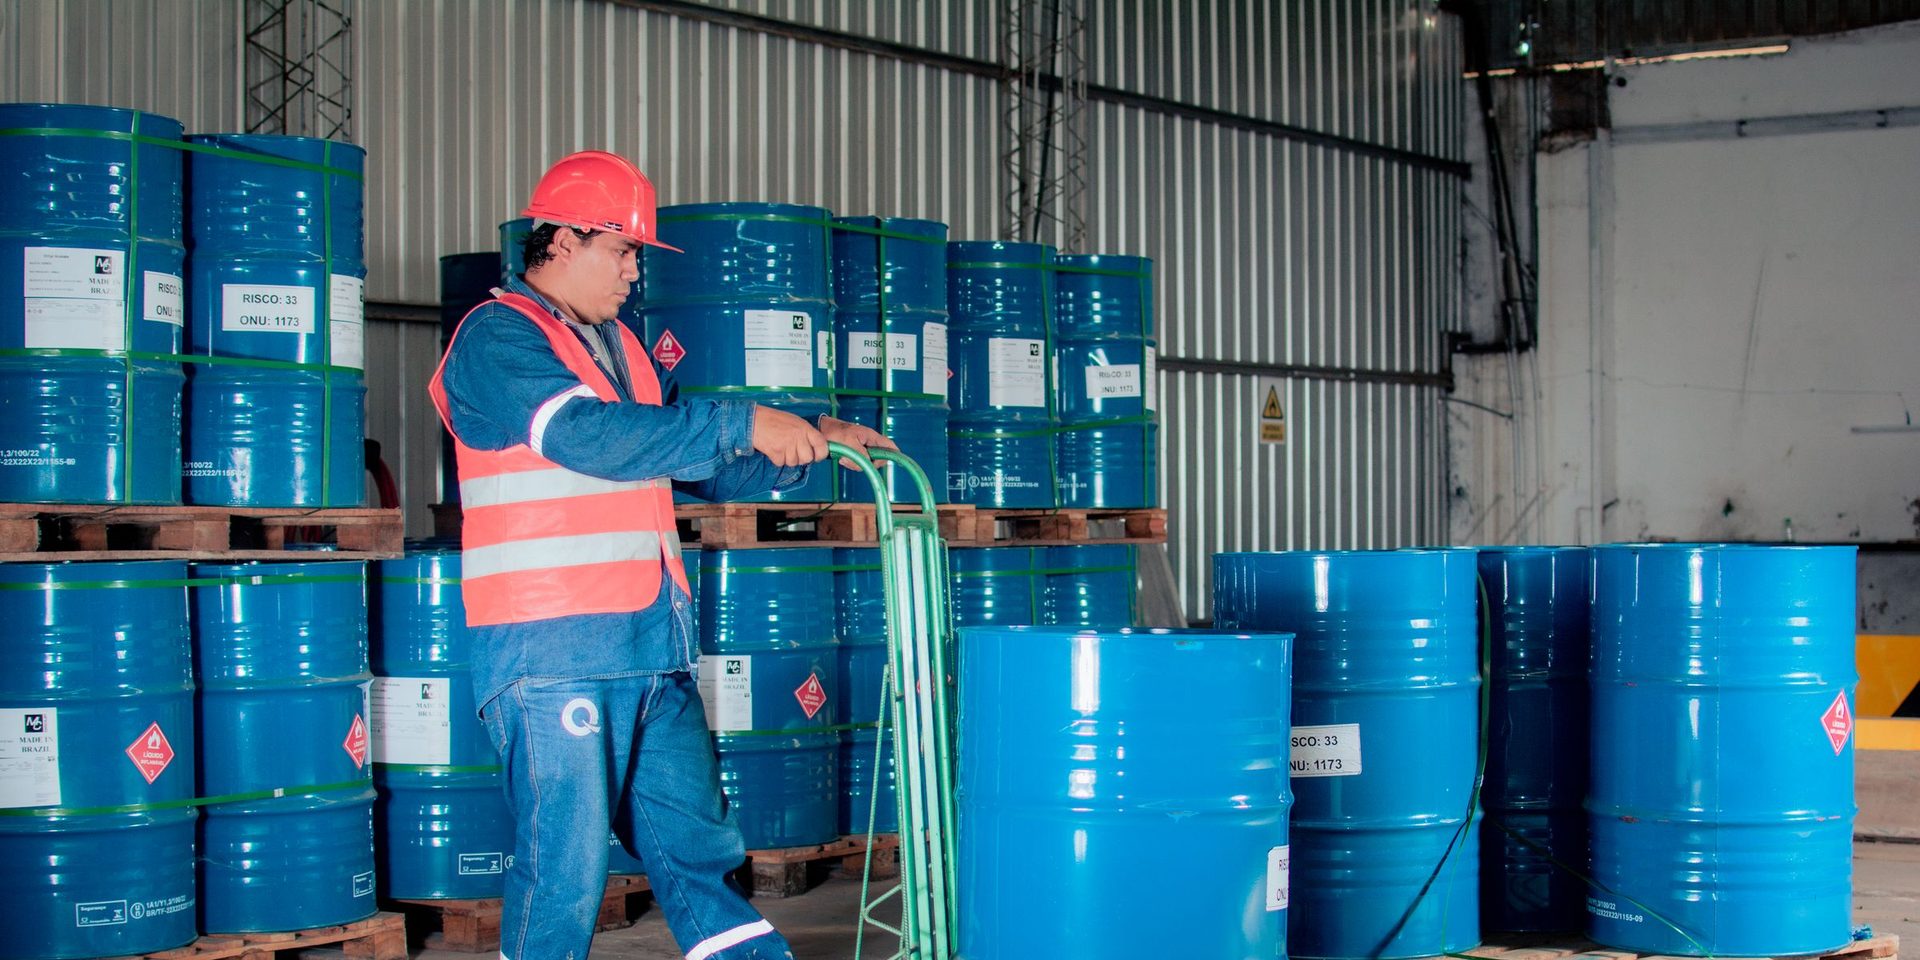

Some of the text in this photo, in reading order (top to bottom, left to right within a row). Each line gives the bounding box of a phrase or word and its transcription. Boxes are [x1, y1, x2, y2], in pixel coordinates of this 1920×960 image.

[243, 294, 298, 305] RISCO: 33
[240, 315, 300, 327] ONU: 1173
[864, 340, 905, 349] RISC 33
[861, 356, 906, 365] ONU 173
[562, 697, 602, 737] Q
[26, 716, 43, 731] MC
[1291, 735, 1338, 747] SCO: 33
[1290, 759, 1342, 771] NU: 1173
